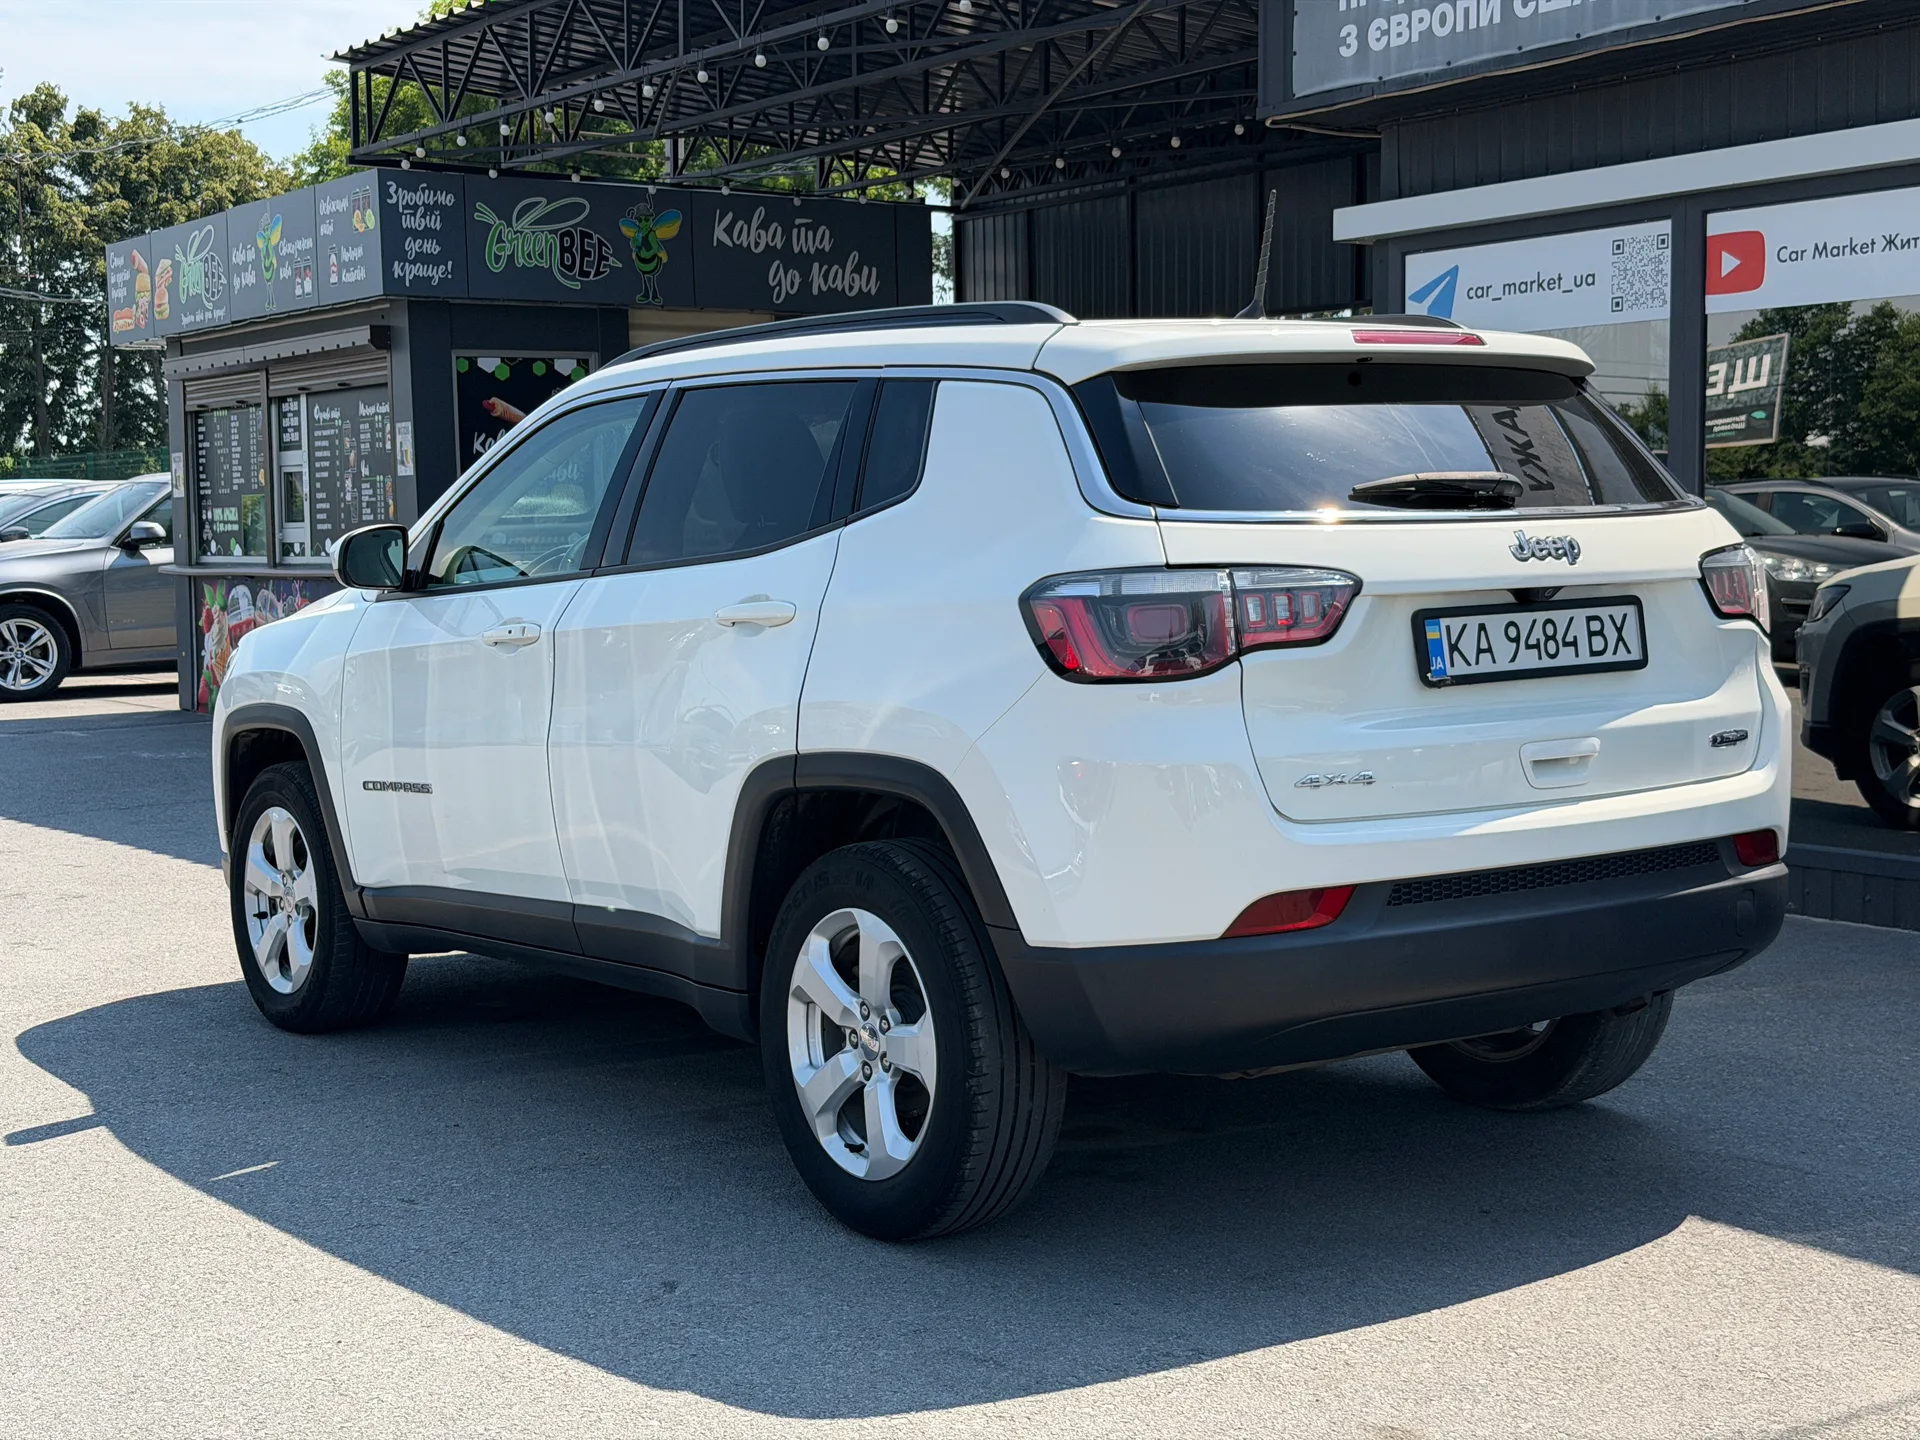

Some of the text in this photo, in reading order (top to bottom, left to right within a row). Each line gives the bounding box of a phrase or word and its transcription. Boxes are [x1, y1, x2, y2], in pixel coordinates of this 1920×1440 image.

[1367, 0, 1501, 51] ЄВРОПИ
[386, 181, 455, 213] Зробимо
[401, 206, 442, 231] твій
[713, 206, 834, 255] Кава та
[404, 237, 441, 260] день
[1776, 233, 1920, 263] Car Market Жит
[392, 260, 453, 287] краще!
[768, 251, 880, 304] до кави
[1466, 271, 1596, 301] car_market_ua
[1508, 529, 1582, 565] Jeep
[1445, 612, 1632, 668] KA 9484 BX
[362, 780, 433, 794] COMPASS
